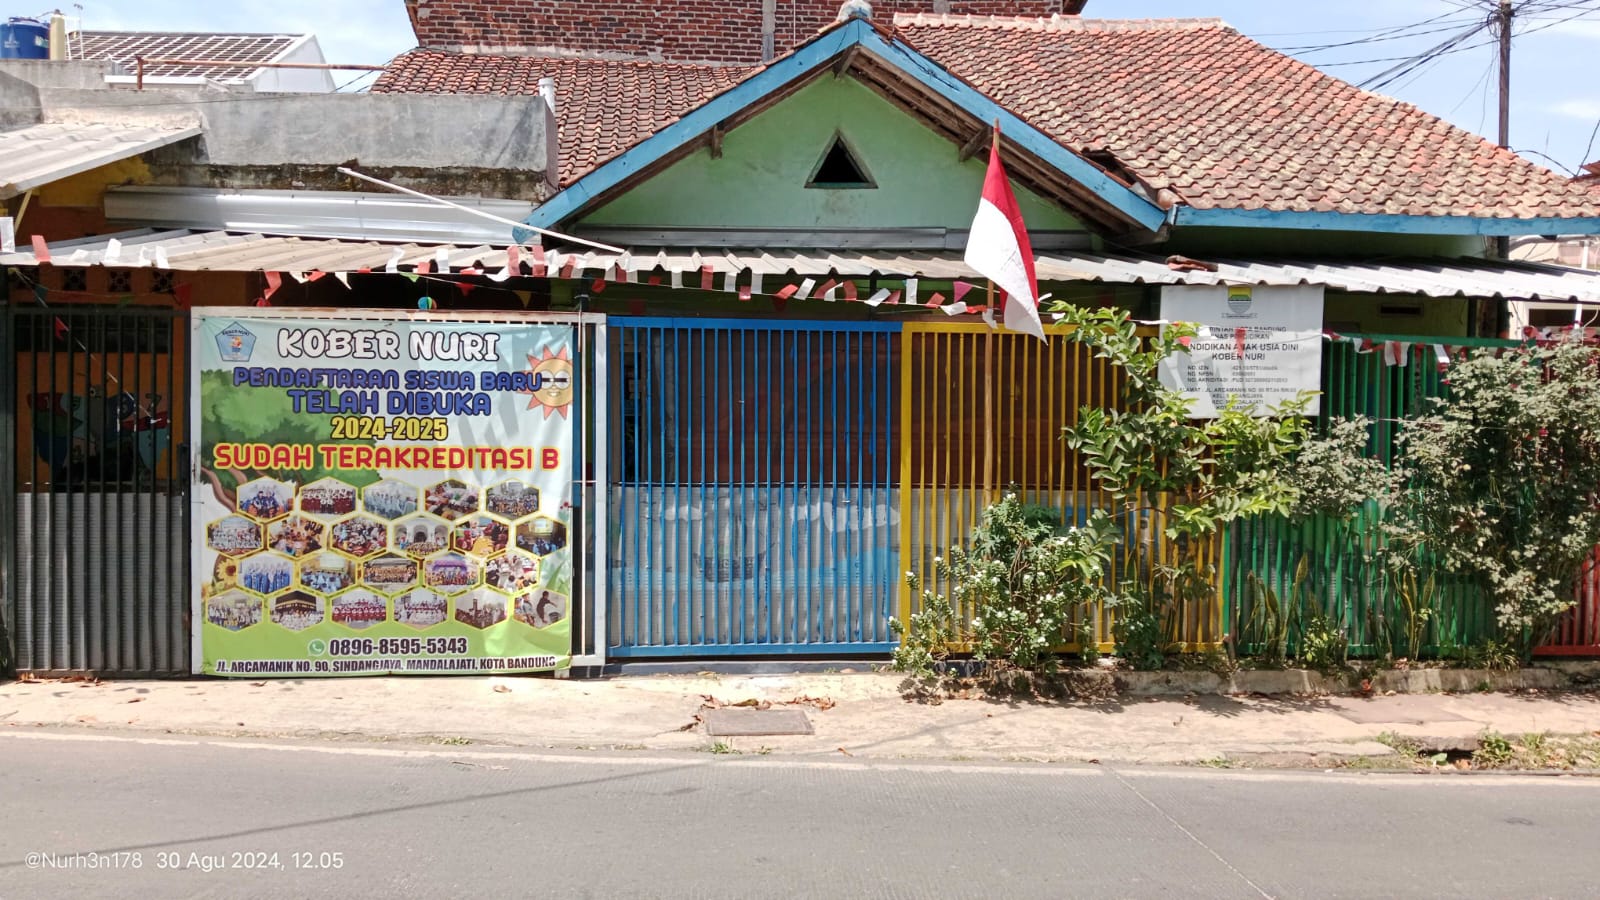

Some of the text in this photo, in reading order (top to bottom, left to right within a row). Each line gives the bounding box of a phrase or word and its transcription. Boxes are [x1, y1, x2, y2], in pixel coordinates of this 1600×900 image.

[277, 328, 500, 361] KOBER NURI
[1190, 343, 1231, 351] NDIDIKAN
[1260, 343, 1280, 351] USIA
[1282, 343, 1299, 351] DINI
[233, 367, 542, 391] PENDAFTARAN SISWA BARU
[287, 389, 492, 416] TELAH DIBUKA
[331, 416, 448, 441] 2024-2025
[214, 443, 560, 471] SUDAH TERAKREDITASI B
[329, 637, 467, 656] 0896-8595-5343
[216, 661, 229, 672] JL.
[231, 661, 295, 673] ARCAMANIK
[296, 661, 313, 672] NO.
[315, 661, 331, 673] 90,
[407, 658, 478, 671] MANDALAJATI,
[480, 658, 506, 670] KOTA
[508, 656, 556, 669] BANDUNG
